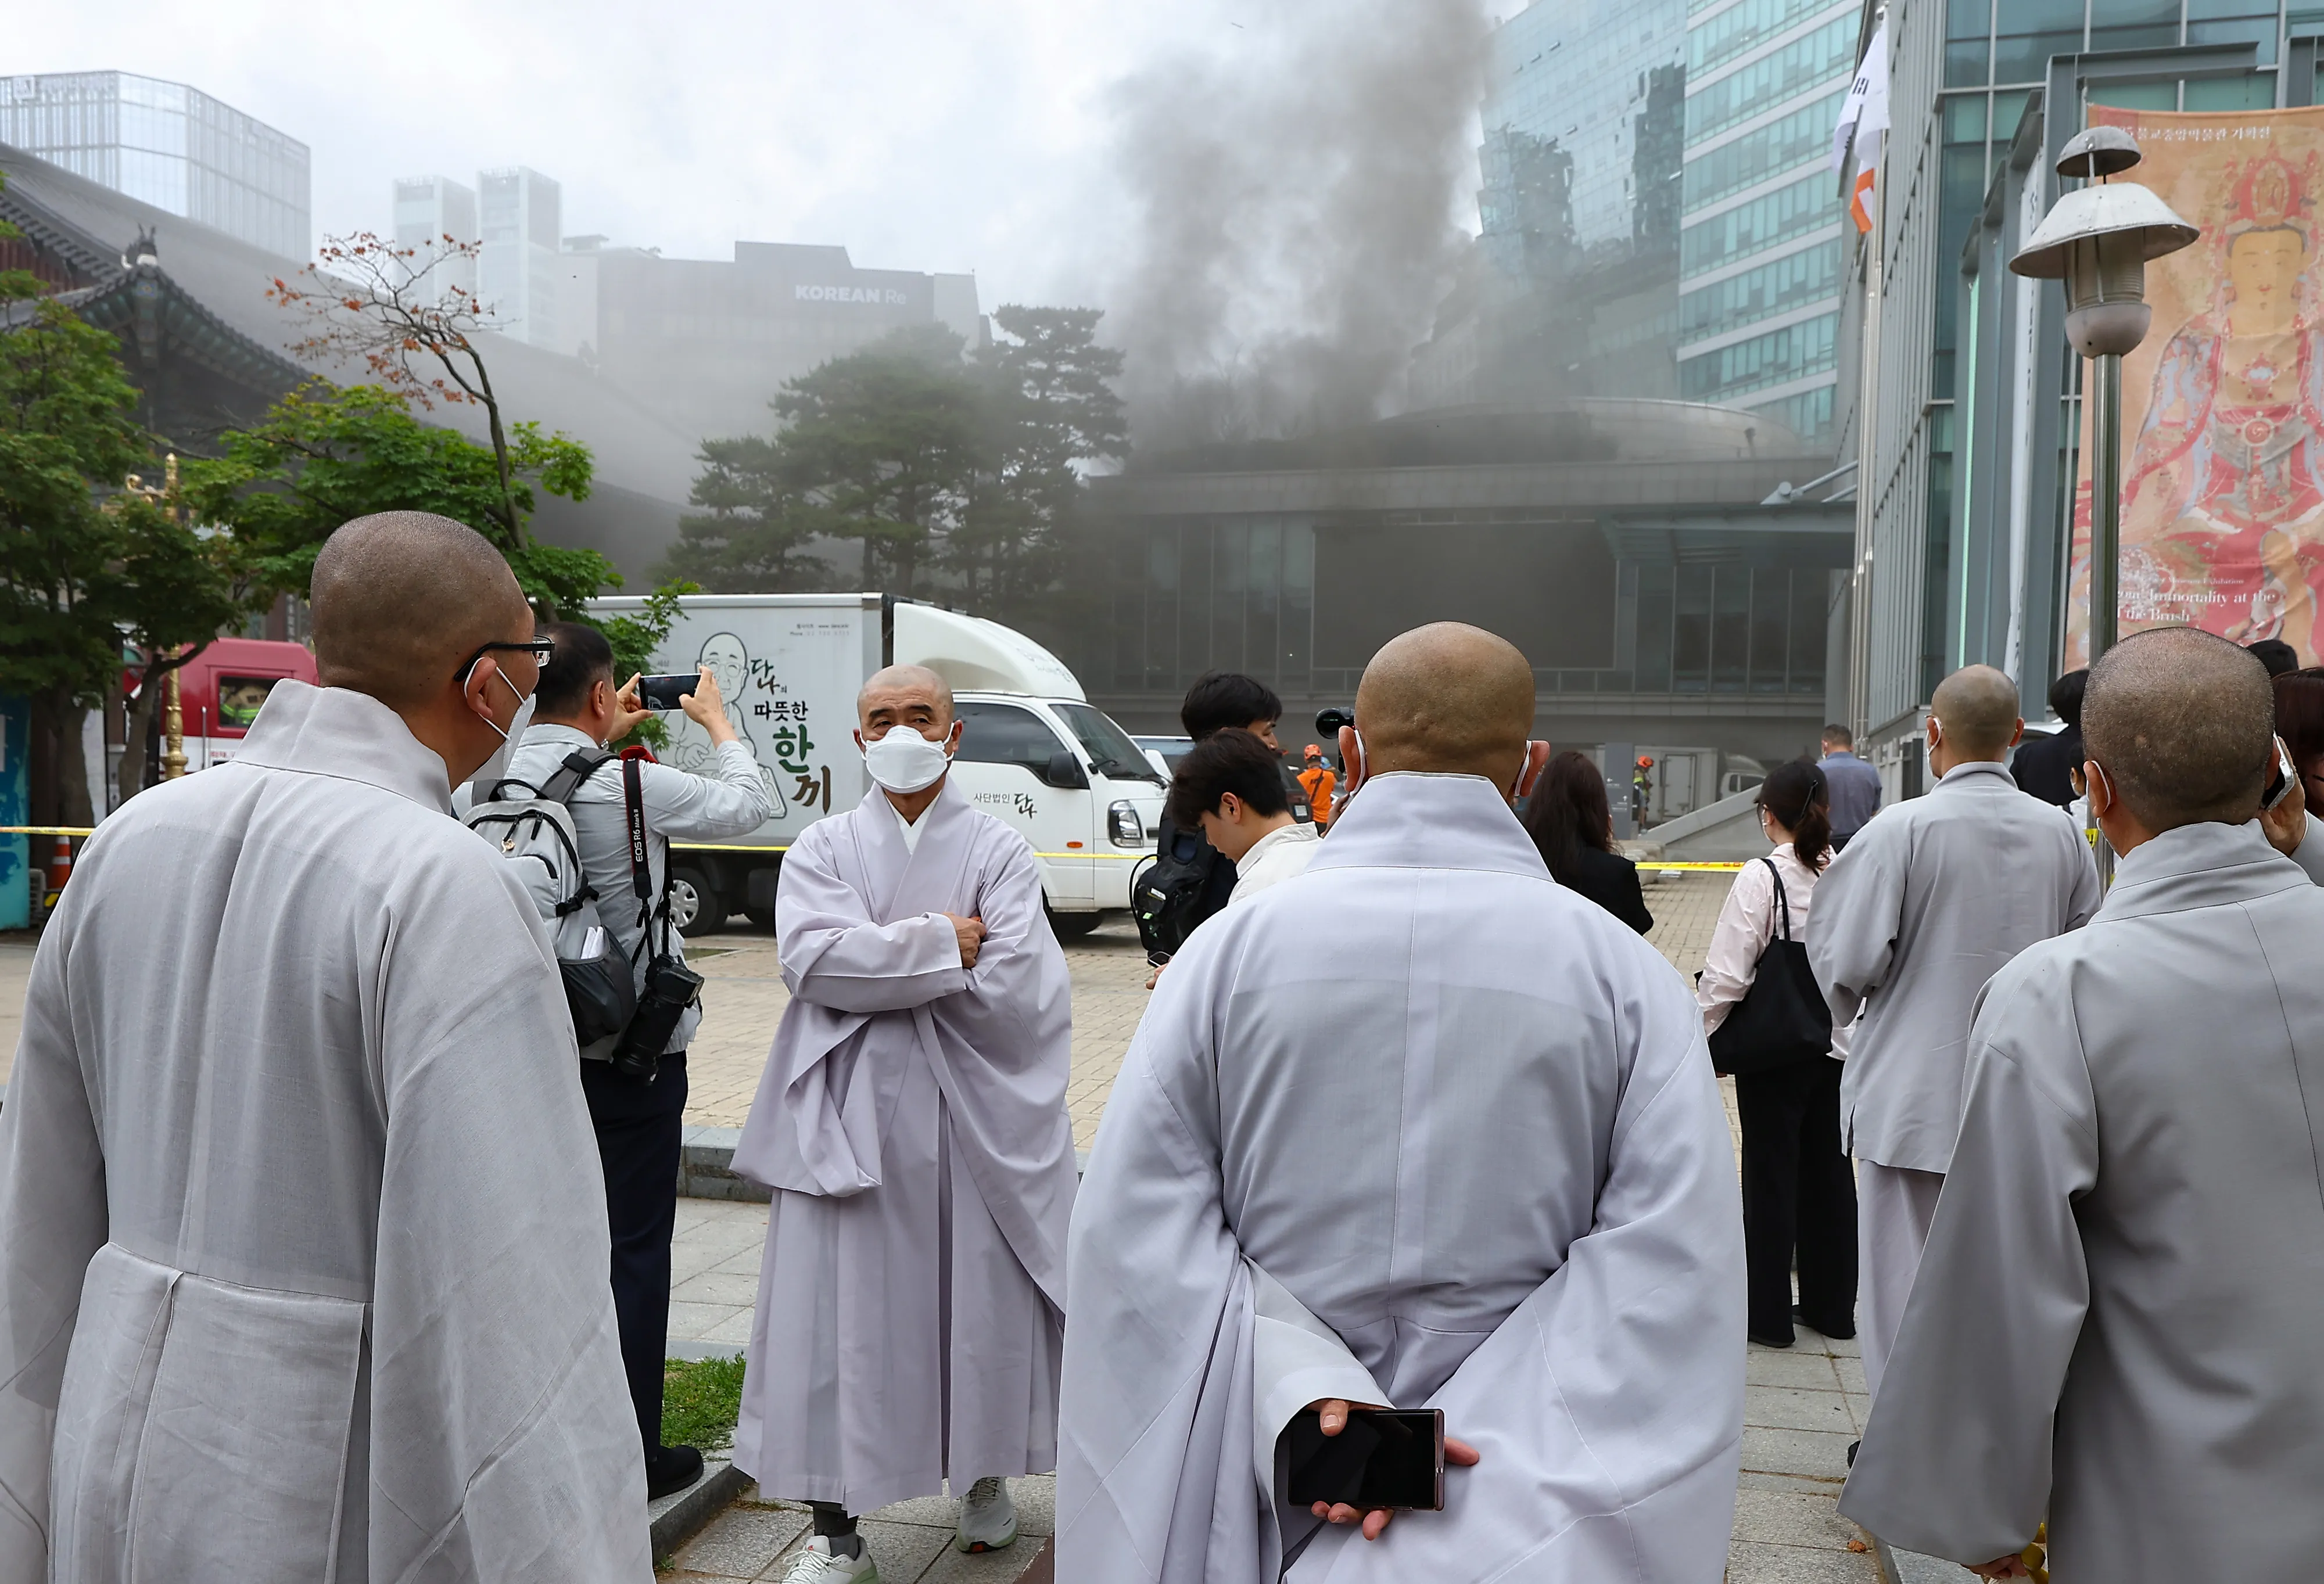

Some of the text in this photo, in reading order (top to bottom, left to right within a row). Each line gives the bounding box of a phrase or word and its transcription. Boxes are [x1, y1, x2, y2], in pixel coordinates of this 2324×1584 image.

[795, 285, 907, 305] KOREAN Re
[2150, 589, 2229, 607] Immortality
[2234, 593, 2247, 603] at
[2253, 590, 2276, 603] the
[2150, 609, 2190, 622] Brush
[754, 701, 808, 721] 따뜻한
[974, 793, 1010, 804] 사단법인
[633, 829, 641, 841] R6
[634, 841, 643, 862] EOS
